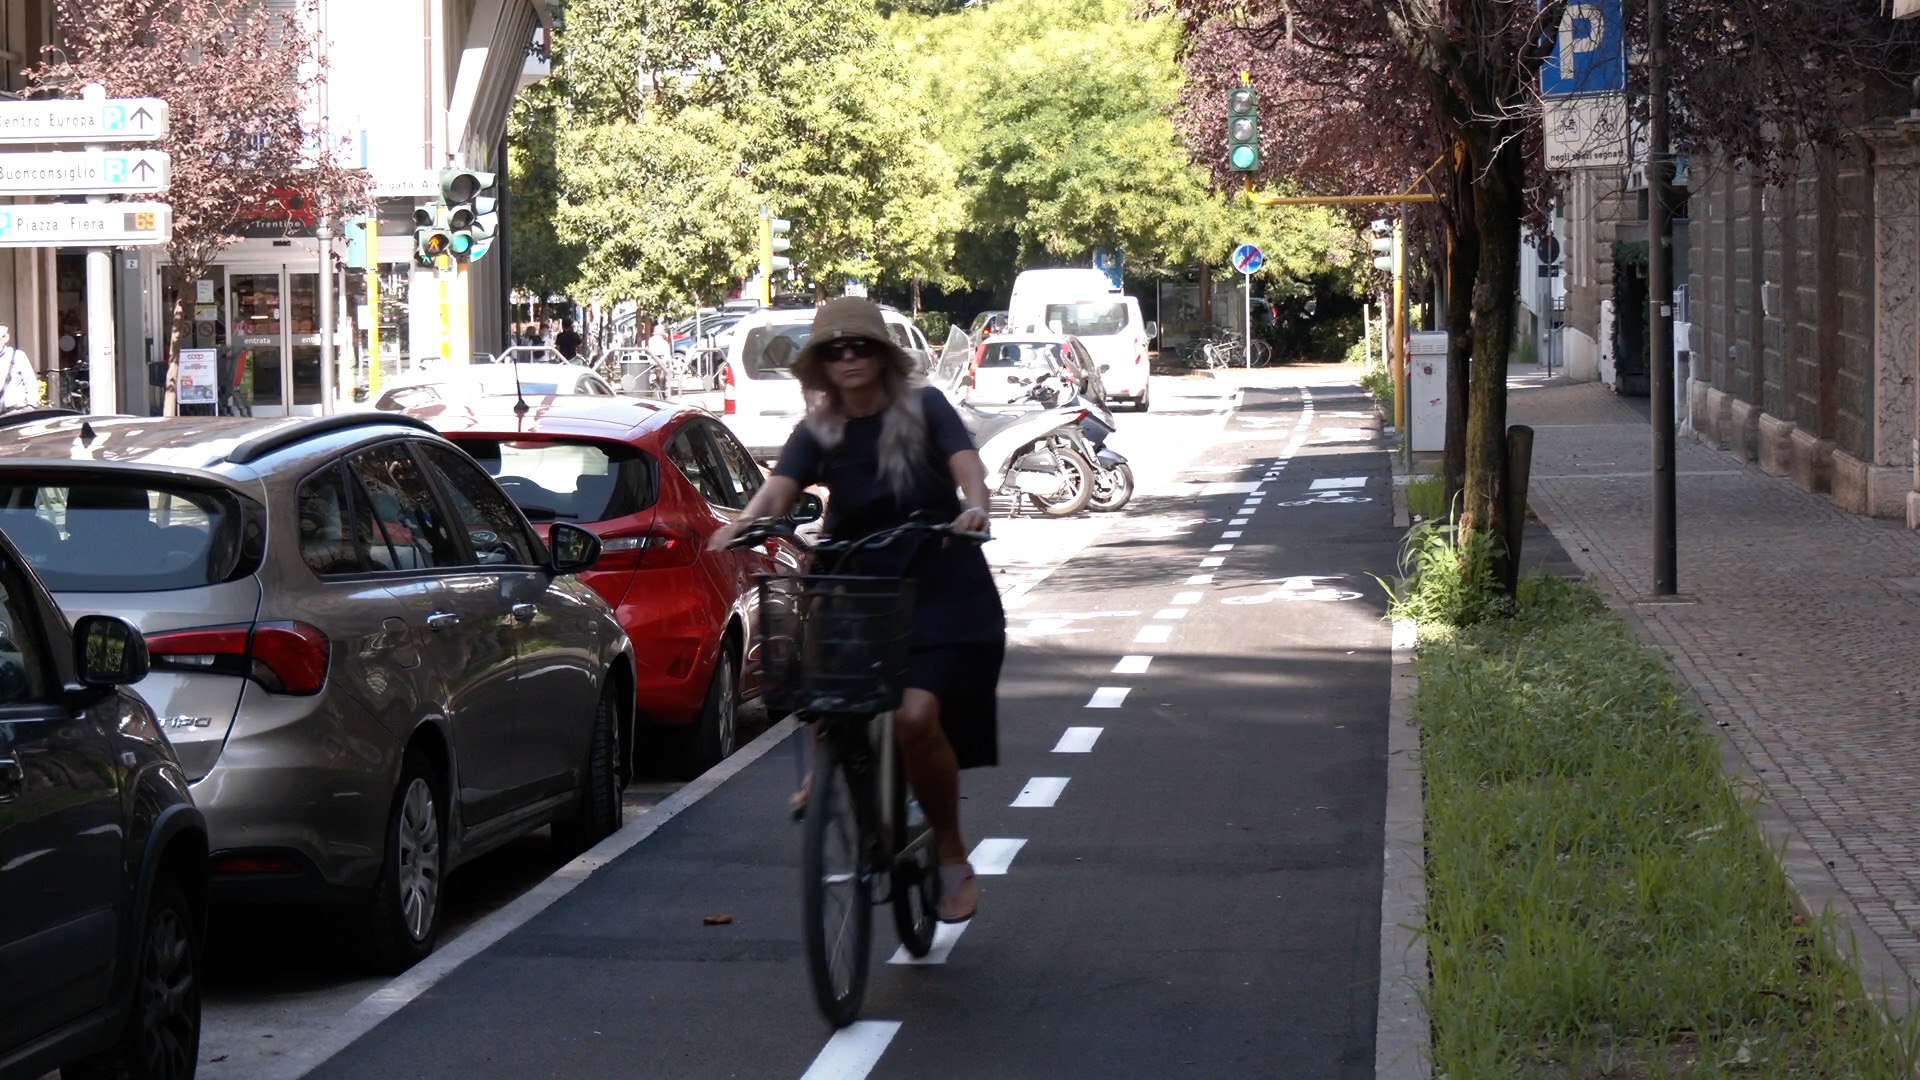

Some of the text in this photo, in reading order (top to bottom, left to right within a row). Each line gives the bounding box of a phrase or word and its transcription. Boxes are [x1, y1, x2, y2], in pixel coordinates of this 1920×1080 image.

[1559, 4, 1605, 80] P
[49, 112, 95, 128] Europa
[1550, 153, 1570, 163] negli
[0, 164, 96, 181] Buonconsiglio
[371, 180, 414, 192] rigata
[17, 217, 59, 231] Piazza
[70, 216, 104, 230] Fiera
[135, 212, 155, 230] 69
[255, 220, 301, 228] Trentino
